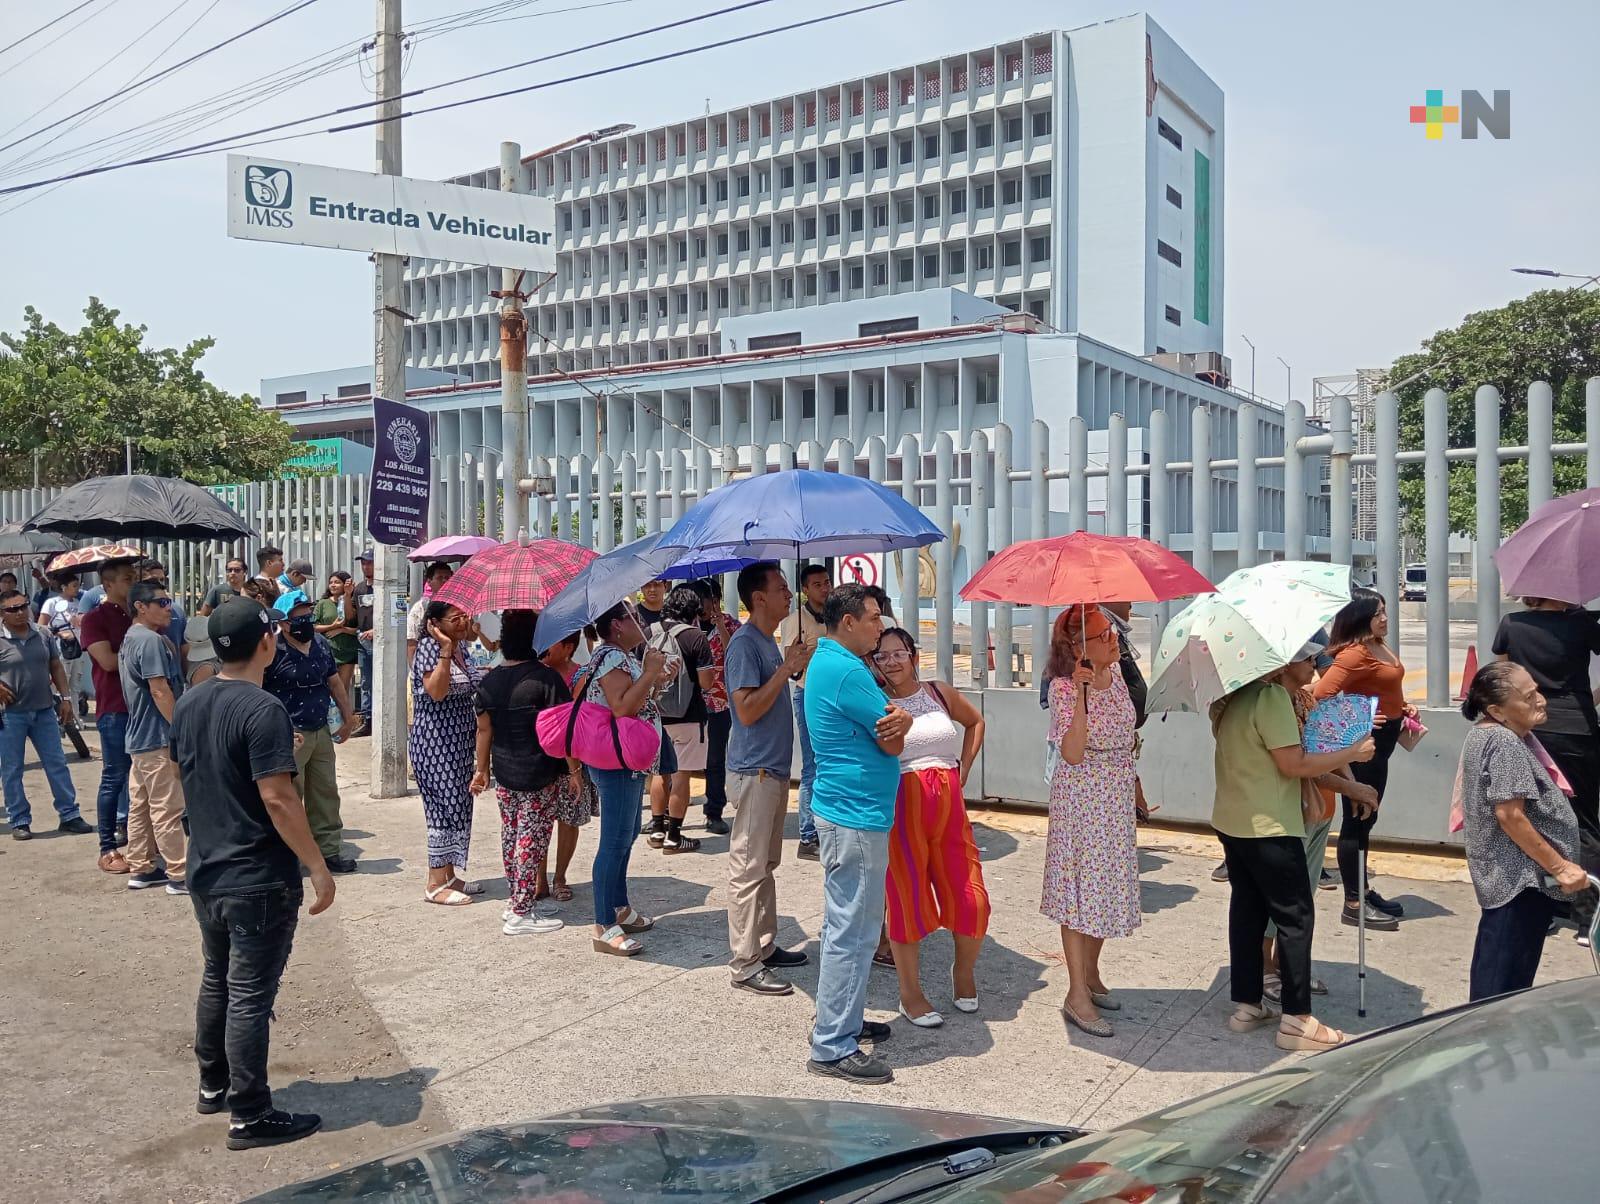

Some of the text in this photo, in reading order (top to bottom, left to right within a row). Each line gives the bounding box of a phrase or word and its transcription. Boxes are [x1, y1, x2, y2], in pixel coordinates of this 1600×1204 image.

[246, 205, 294, 229] IMSS
[309, 196, 553, 246] Entrada Vehicular
[386, 417, 421, 445] FUNERARIA
[384, 460, 398, 470] LOS
[376, 479, 428, 499] 229 439 8454
